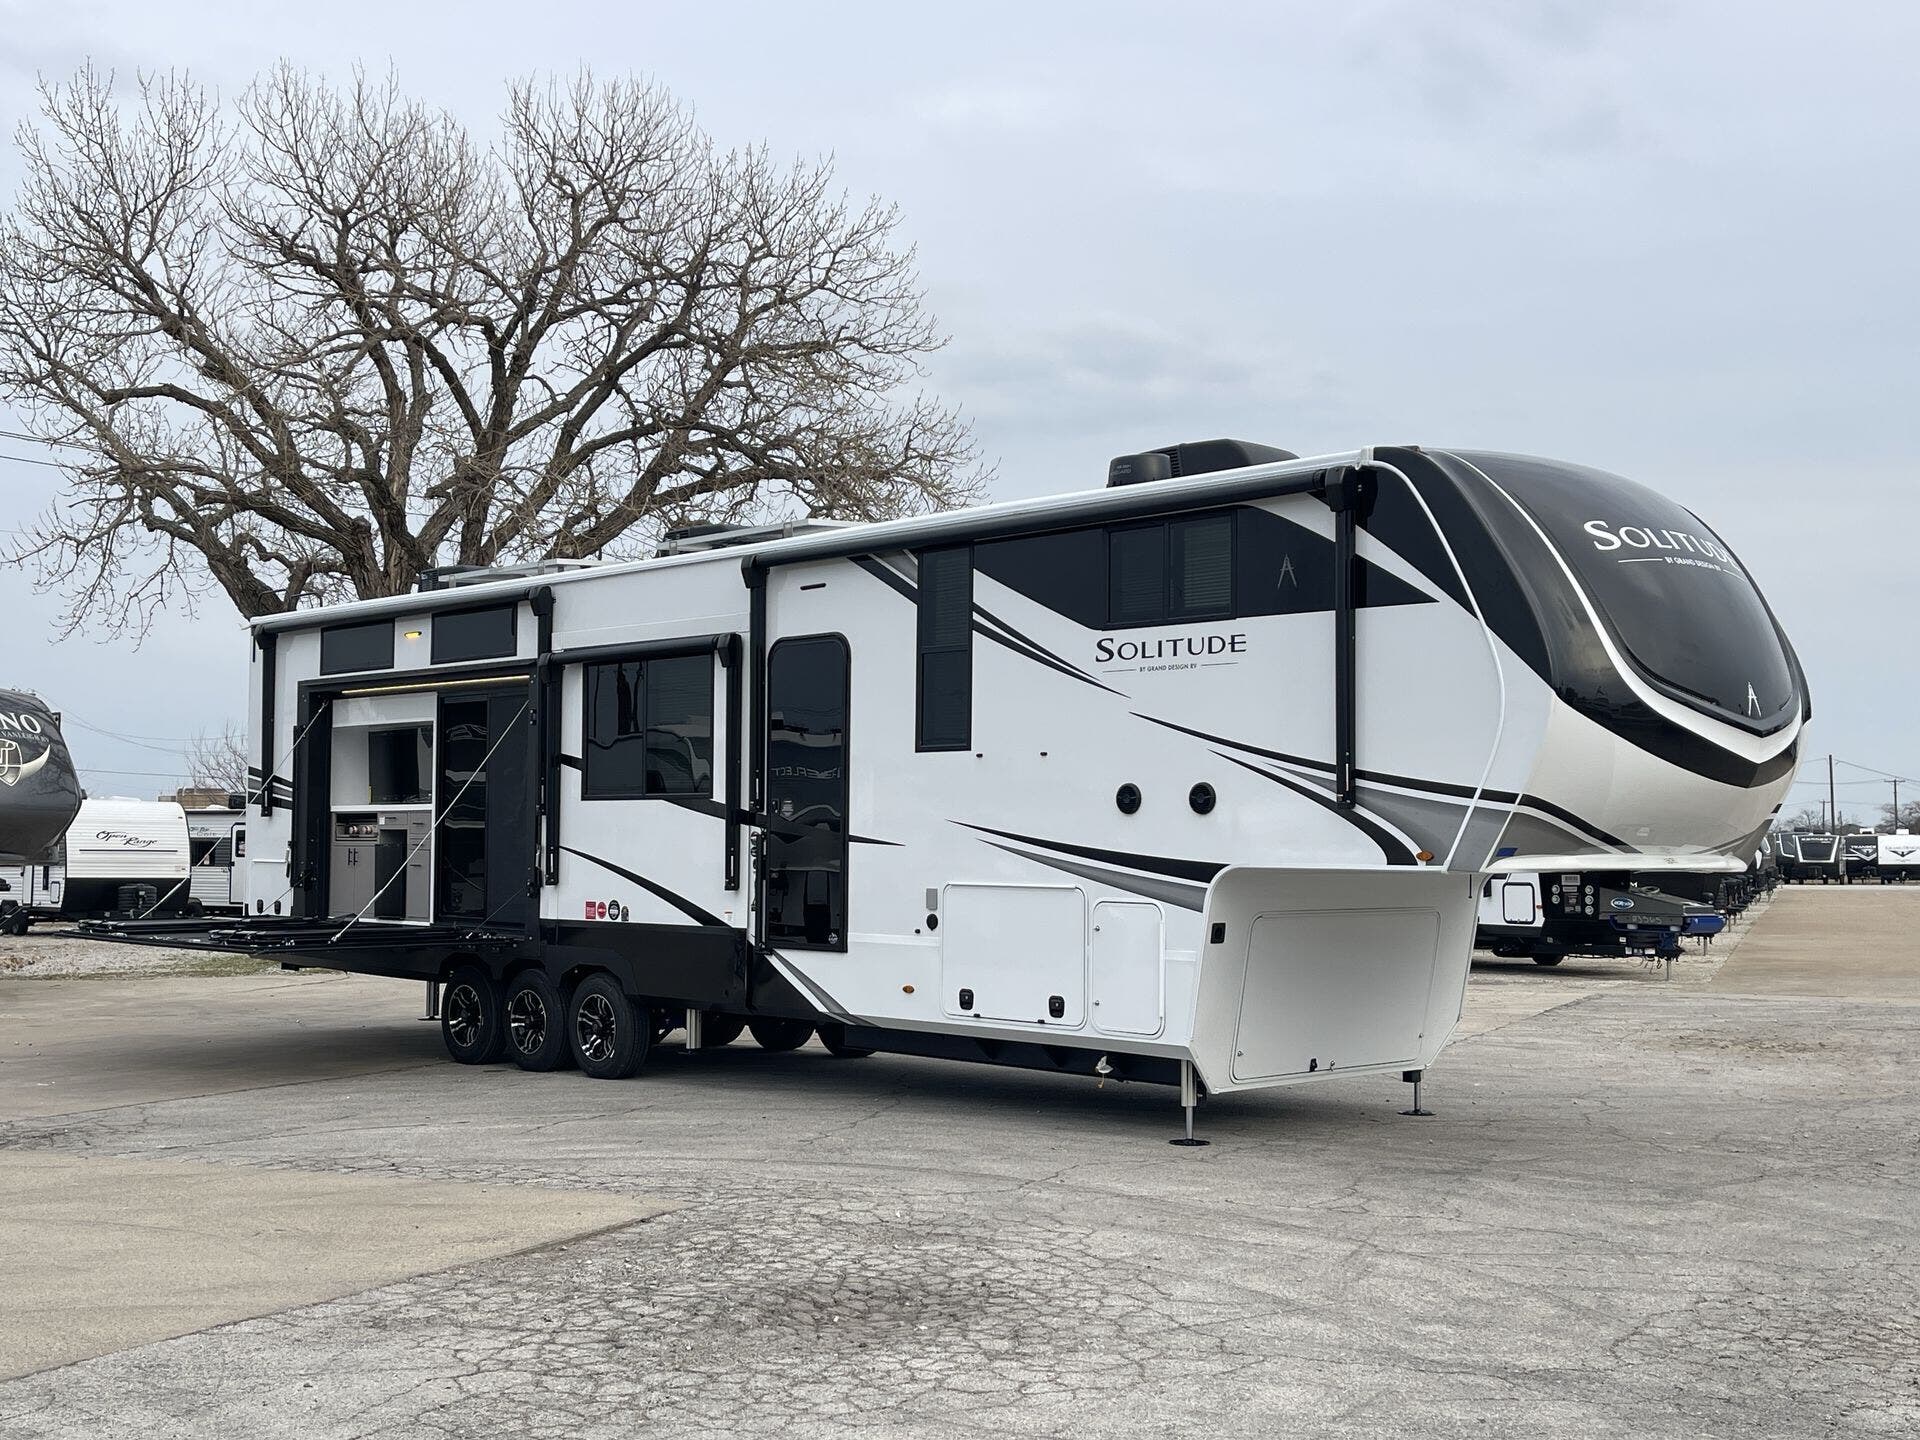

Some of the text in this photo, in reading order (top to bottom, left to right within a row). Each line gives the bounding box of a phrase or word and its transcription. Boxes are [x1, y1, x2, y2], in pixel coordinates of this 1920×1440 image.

[1095, 633, 1247, 663] SOLITUDE
[1147, 664, 1167, 672] GRAND
[1168, 662, 1189, 670] DESIGN
[96, 830, 127, 841] Open
[123, 837, 158, 848] Range
